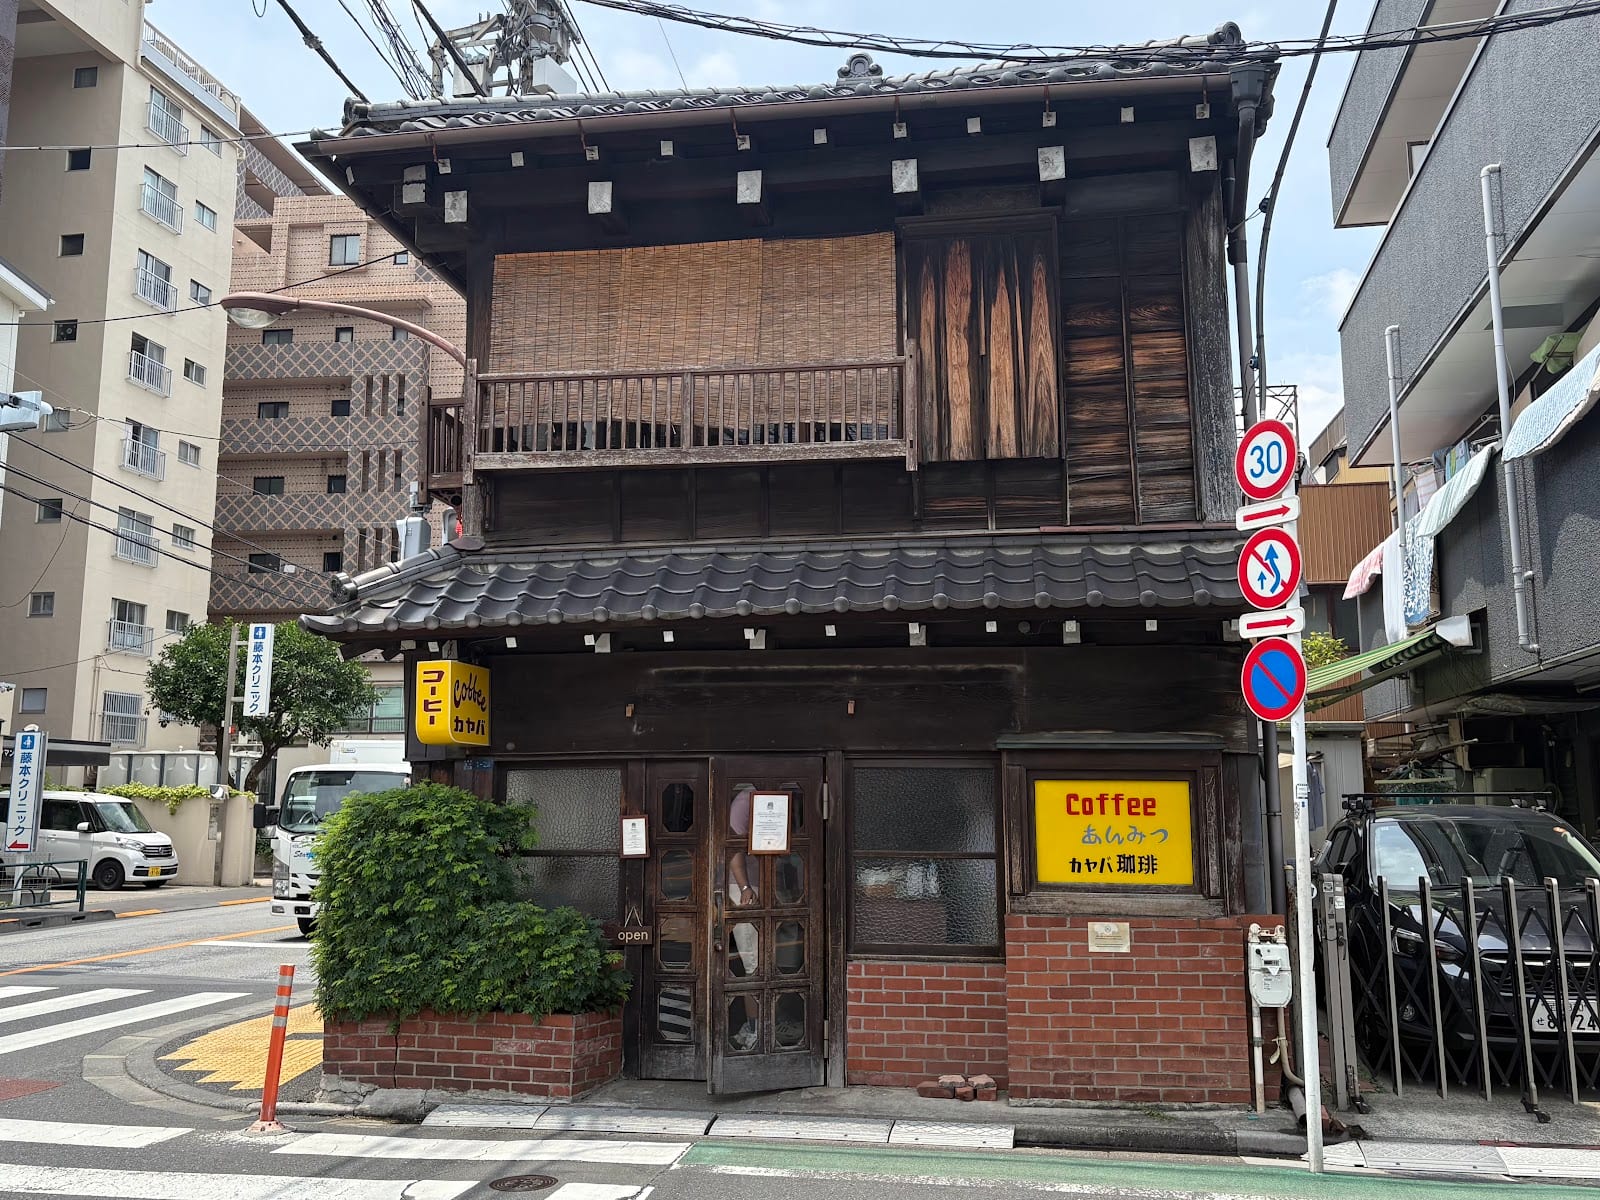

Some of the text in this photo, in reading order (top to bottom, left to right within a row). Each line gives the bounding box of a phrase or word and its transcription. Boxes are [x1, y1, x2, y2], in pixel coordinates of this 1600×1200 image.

[1249, 440, 1283, 479] 30
[249, 641, 264, 713] 藤本クリニック
[453, 672, 487, 712] Coffee
[423, 670, 445, 725] コーヒー
[453, 716, 486, 735] カヤバ
[14, 752, 33, 836] 藤本クリニック
[1066, 793, 1157, 816] Coffee
[1081, 824, 1169, 845] あんみつ
[1068, 854, 1158, 875] カヤバ珈琲
[617, 931, 648, 943] open
